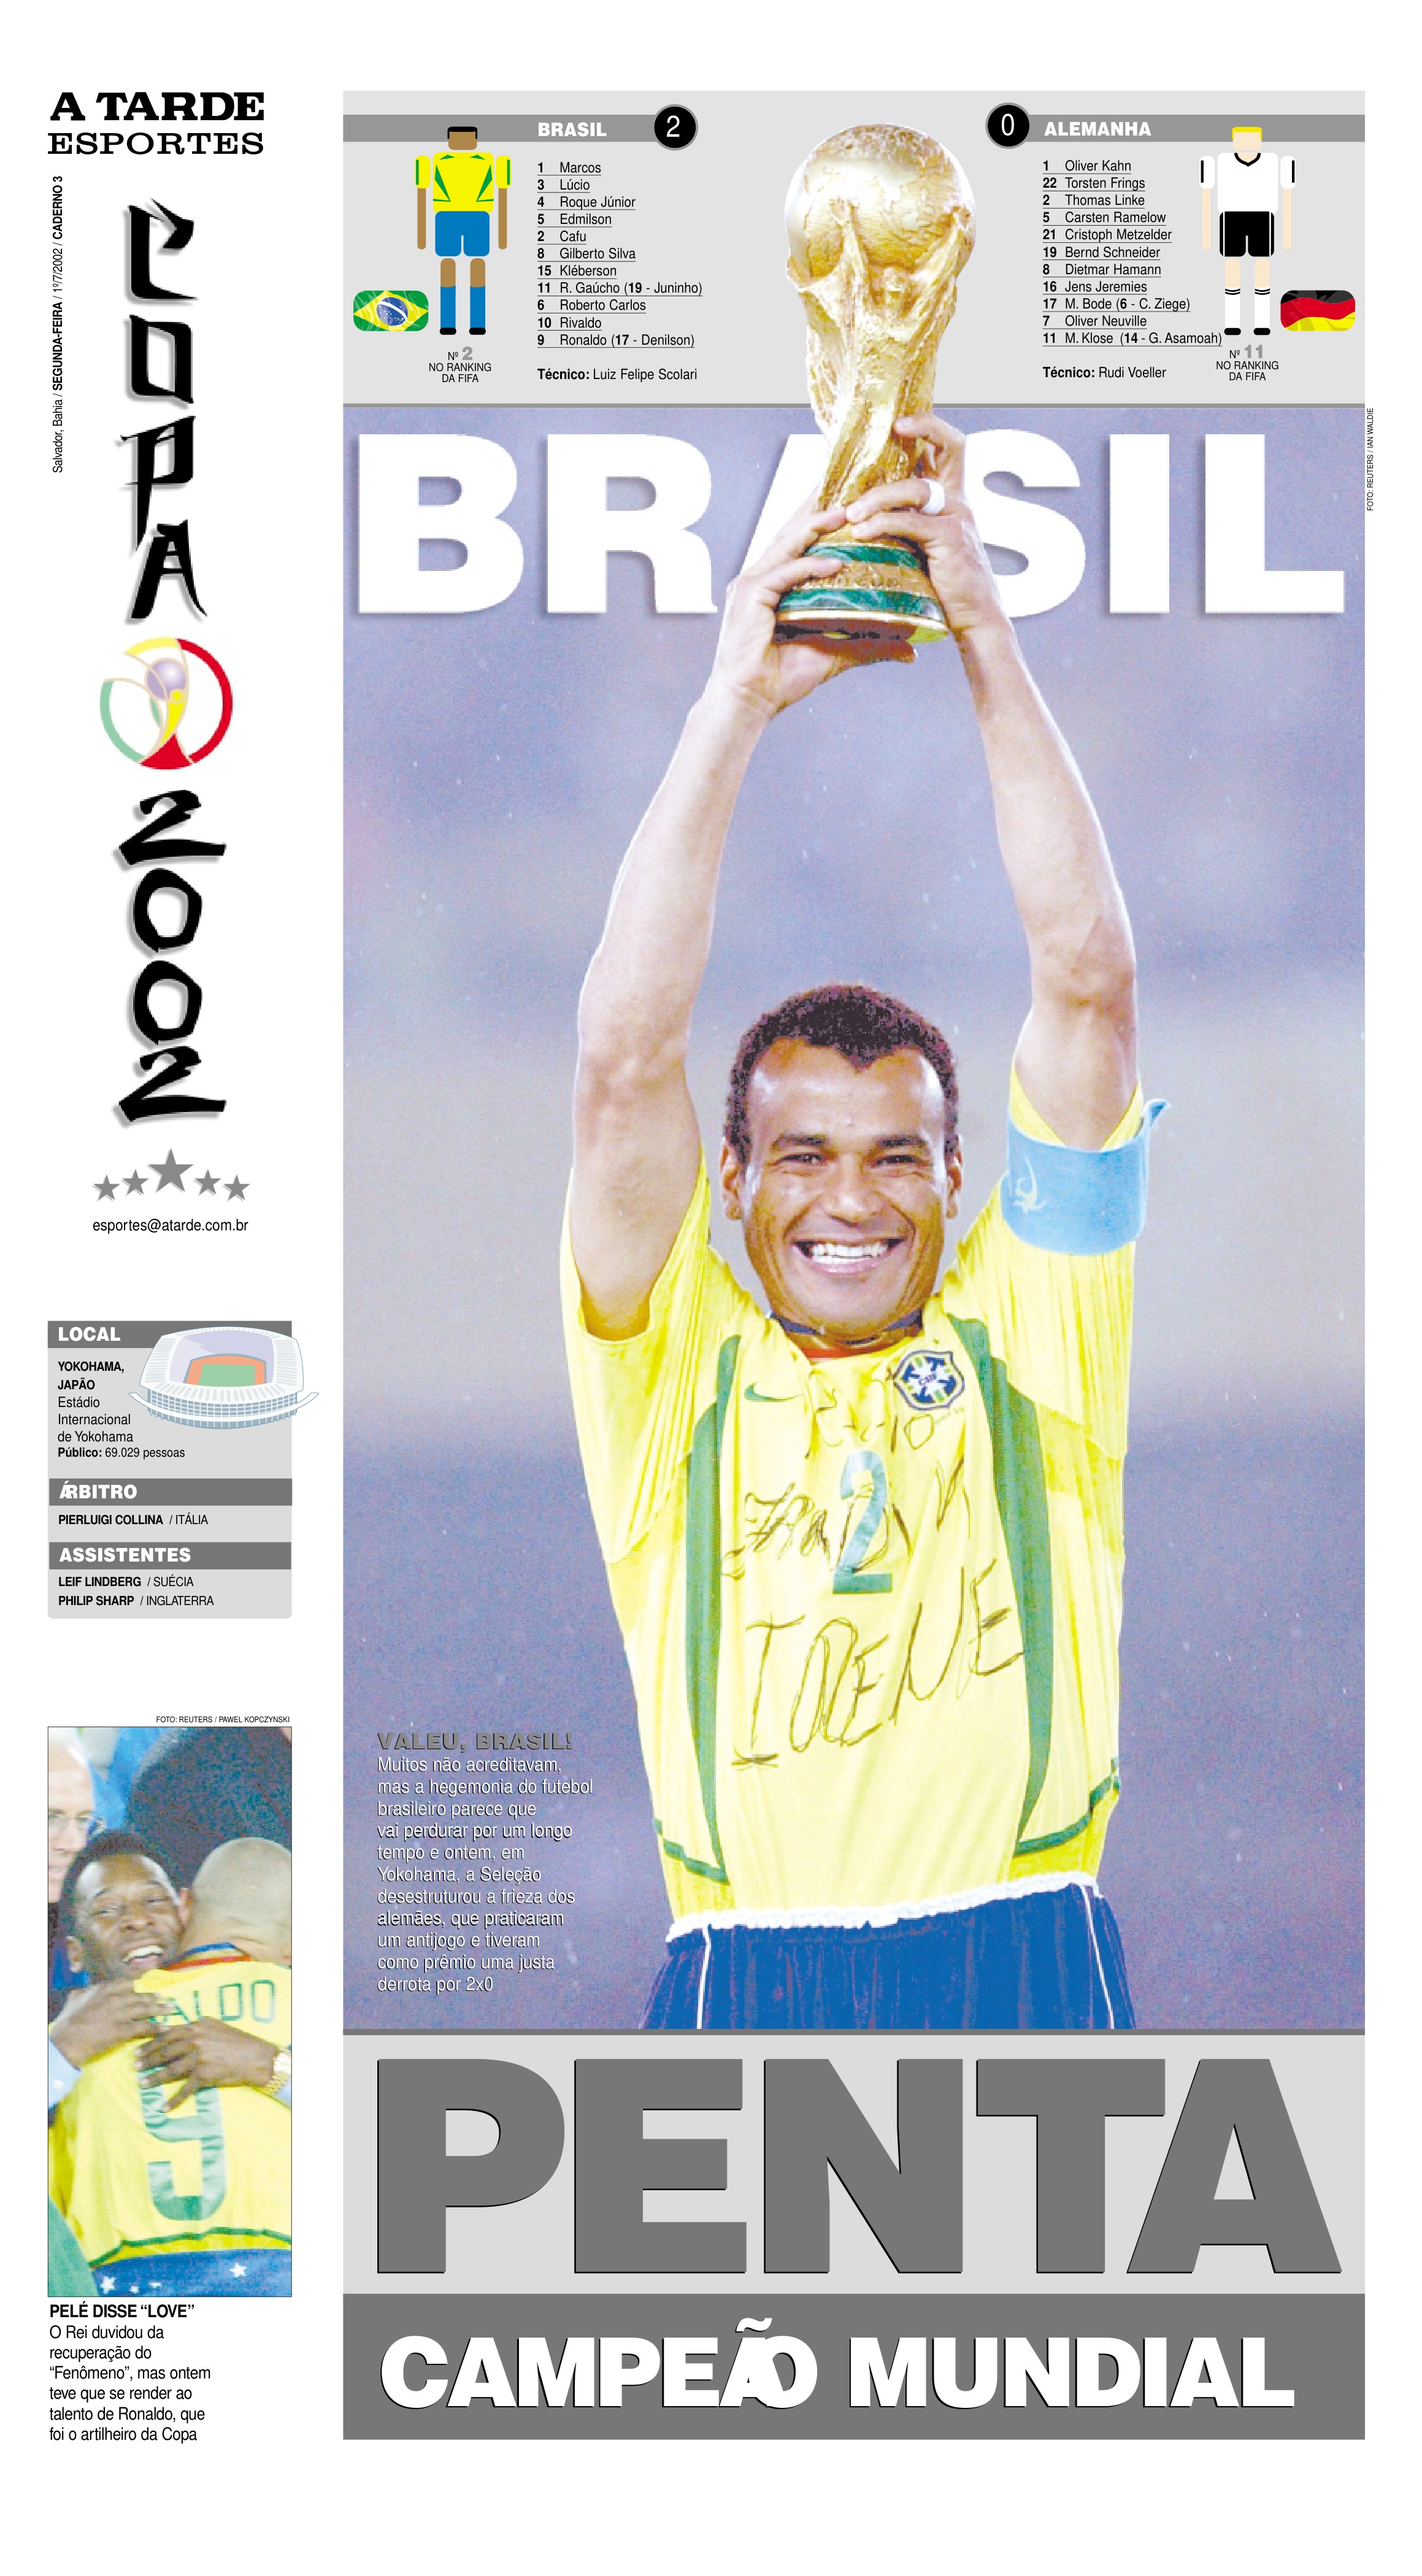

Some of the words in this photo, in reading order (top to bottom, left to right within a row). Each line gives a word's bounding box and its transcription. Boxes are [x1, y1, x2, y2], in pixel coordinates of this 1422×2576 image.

[50, 92, 86, 121] A
[95, 91, 264, 121] TARDE
[538, 122, 607, 137] BRASIL
[666, 115, 680, 137] 2
[1001, 113, 1015, 136] 0
[1044, 121, 1151, 136] ALEMANHA
[47, 132, 264, 155] ESPORTES
[537, 162, 543, 173] 1
[560, 161, 601, 174] Marcos
[1043, 160, 1048, 171] 1
[1065, 159, 1098, 172] Oliver
[1102, 159, 1131, 172] Kahn
[537, 178, 545, 191] 3
[560, 178, 590, 191] Lúcio
[1042, 177, 1057, 188] 22
[1064, 177, 1106, 189] Torsten
[1111, 177, 1145, 191] Frings
[537, 196, 545, 207] 4
[560, 196, 597, 210] Roque
[601, 196, 636, 208] Júnior
[52, 185, 63, 240] CADERNO
[537, 213, 545, 225] 5
[560, 213, 612, 225] Edmilson
[1042, 212, 1050, 223] 5
[1065, 211, 1109, 223] Carsten
[1114, 211, 1166, 223] Ramelow
[1042, 228, 1055, 240] 21
[1065, 228, 1112, 243] Cristoph
[1116, 228, 1172, 240] Metzelder
[537, 247, 545, 259] 8
[559, 247, 605, 259] Gilberto
[609, 247, 636, 259] Silva
[537, 265, 552, 277] 15
[560, 264, 617, 277] Kléberson
[1042, 263, 1050, 275] 8
[1066, 263, 1110, 275] Dietmar
[1113, 263, 1161, 275] Hamann
[1043, 280, 1057, 293] 16
[1064, 280, 1092, 293] Jens
[1095, 280, 1147, 293] Jeremies
[537, 299, 545, 311] 6
[560, 299, 605, 311] Roberto
[609, 299, 646, 311] Carlos
[537, 316, 552, 329] 10
[560, 316, 602, 329] Rivaldo
[1042, 315, 1050, 326] 7
[1065, 315, 1098, 327] Oliver
[1102, 315, 1147, 327] Neuville
[52, 301, 63, 391] SEGUNDA-FEIRA
[462, 346, 473, 361] 2
[1244, 344, 1263, 359] 11
[429, 362, 444, 372] NO
[447, 362, 491, 372] RANKING
[1042, 366, 1095, 378] Técnico:
[1099, 366, 1124, 378] Rudi
[1128, 366, 1167, 378] Voeller
[1216, 361, 1231, 370] NO
[1234, 361, 1279, 370] RANKING
[442, 374, 455, 383] DA
[458, 374, 479, 383] FIFA
[537, 368, 590, 380] Técnico:
[593, 368, 617, 380] Luiz
[621, 368, 655, 383] Felipe
[658, 368, 697, 380] Scolari
[1229, 372, 1243, 381] DA
[1245, 372, 1266, 381] FIFA
[52, 399, 63, 426] Bahia
[121, 199, 207, 620] COPA
[52, 429, 64, 473] Salvador,
[118, 789, 227, 1122] 2002
[93, 1218, 248, 1235] esportes@atarde.com.br
[58, 1326, 121, 1341] LOCAL
[58, 1361, 125, 1373] YOKOHAMA,
[57, 1377, 95, 1390] JAPÃO
[58, 1396, 100, 1408] Estádio
[58, 1413, 131, 1425] Internacional
[57, 1430, 72, 1443] de
[74, 1430, 134, 1443] Yokohama
[58, 1446, 102, 1458] Público:
[105, 1447, 140, 1458] 69.029
[143, 1449, 185, 1460] pessoas
[59, 1480, 137, 1499] ÁRBITRO
[58, 1514, 112, 1525] PIERLUIGI
[115, 1514, 164, 1525] COLLINA
[175, 1512, 209, 1525] ITÁLIA
[833, 1449, 893, 1594] 2
[59, 1547, 191, 1562] ASSISTENTES
[377, 1733, 464, 1754] VALEU,
[476, 1733, 572, 1750] BRASIL!
[379, 1757, 427, 1771] Muitos
[434, 1757, 461, 1771] não
[466, 1757, 561, 1774] acreditavam,
[379, 1782, 409, 1793] mas
[415, 1782, 424, 1793] a
[430, 1779, 513, 1797] hegemonia
[518, 1779, 537, 1793] do
[542, 1779, 592, 1793] futebol
[378, 1801, 446, 1815] brasileiro
[452, 1804, 502, 1819] parece
[509, 1804, 536, 1819] que
[378, 1866, 459, 1884] Yokohama,
[466, 1870, 475, 1881] a
[481, 1866, 541, 1885] Seleção
[378, 1910, 445, 1927] alemães,
[452, 1914, 479, 1928] que
[485, 1910, 564, 1928] praticaram
[378, 1976, 431, 1991] derrota
[437, 1980, 461, 1995] por
[466, 1976, 493, 1991] 2x0
[148, 1979, 276, 2024] ALDO
[137, 2064, 227, 2221] 9
[377, 2058, 1343, 2274] PENTA
[50, 2301, 88, 2318] PELÉ
[93, 2304, 137, 2318] DISSE
[49, 2325, 61, 2339] O
[66, 2325, 87, 2339] Rei
[91, 2325, 143, 2339] duvidou
[147, 2325, 164, 2339] da
[50, 2345, 131, 2363] recuperação
[135, 2345, 152, 2359] do
[382, 2317, 818, 2409] CAMPEÃO
[850, 2337, 1295, 2409] MUNDIAL
[137, 2369, 166, 2380] mas
[169, 2366, 210, 2380] ontem
[49, 2407, 93, 2421] talento
[97, 2407, 114, 2421] de
[118, 2406, 175, 2423] Ronaldo,
[180, 2410, 205, 2424] que
